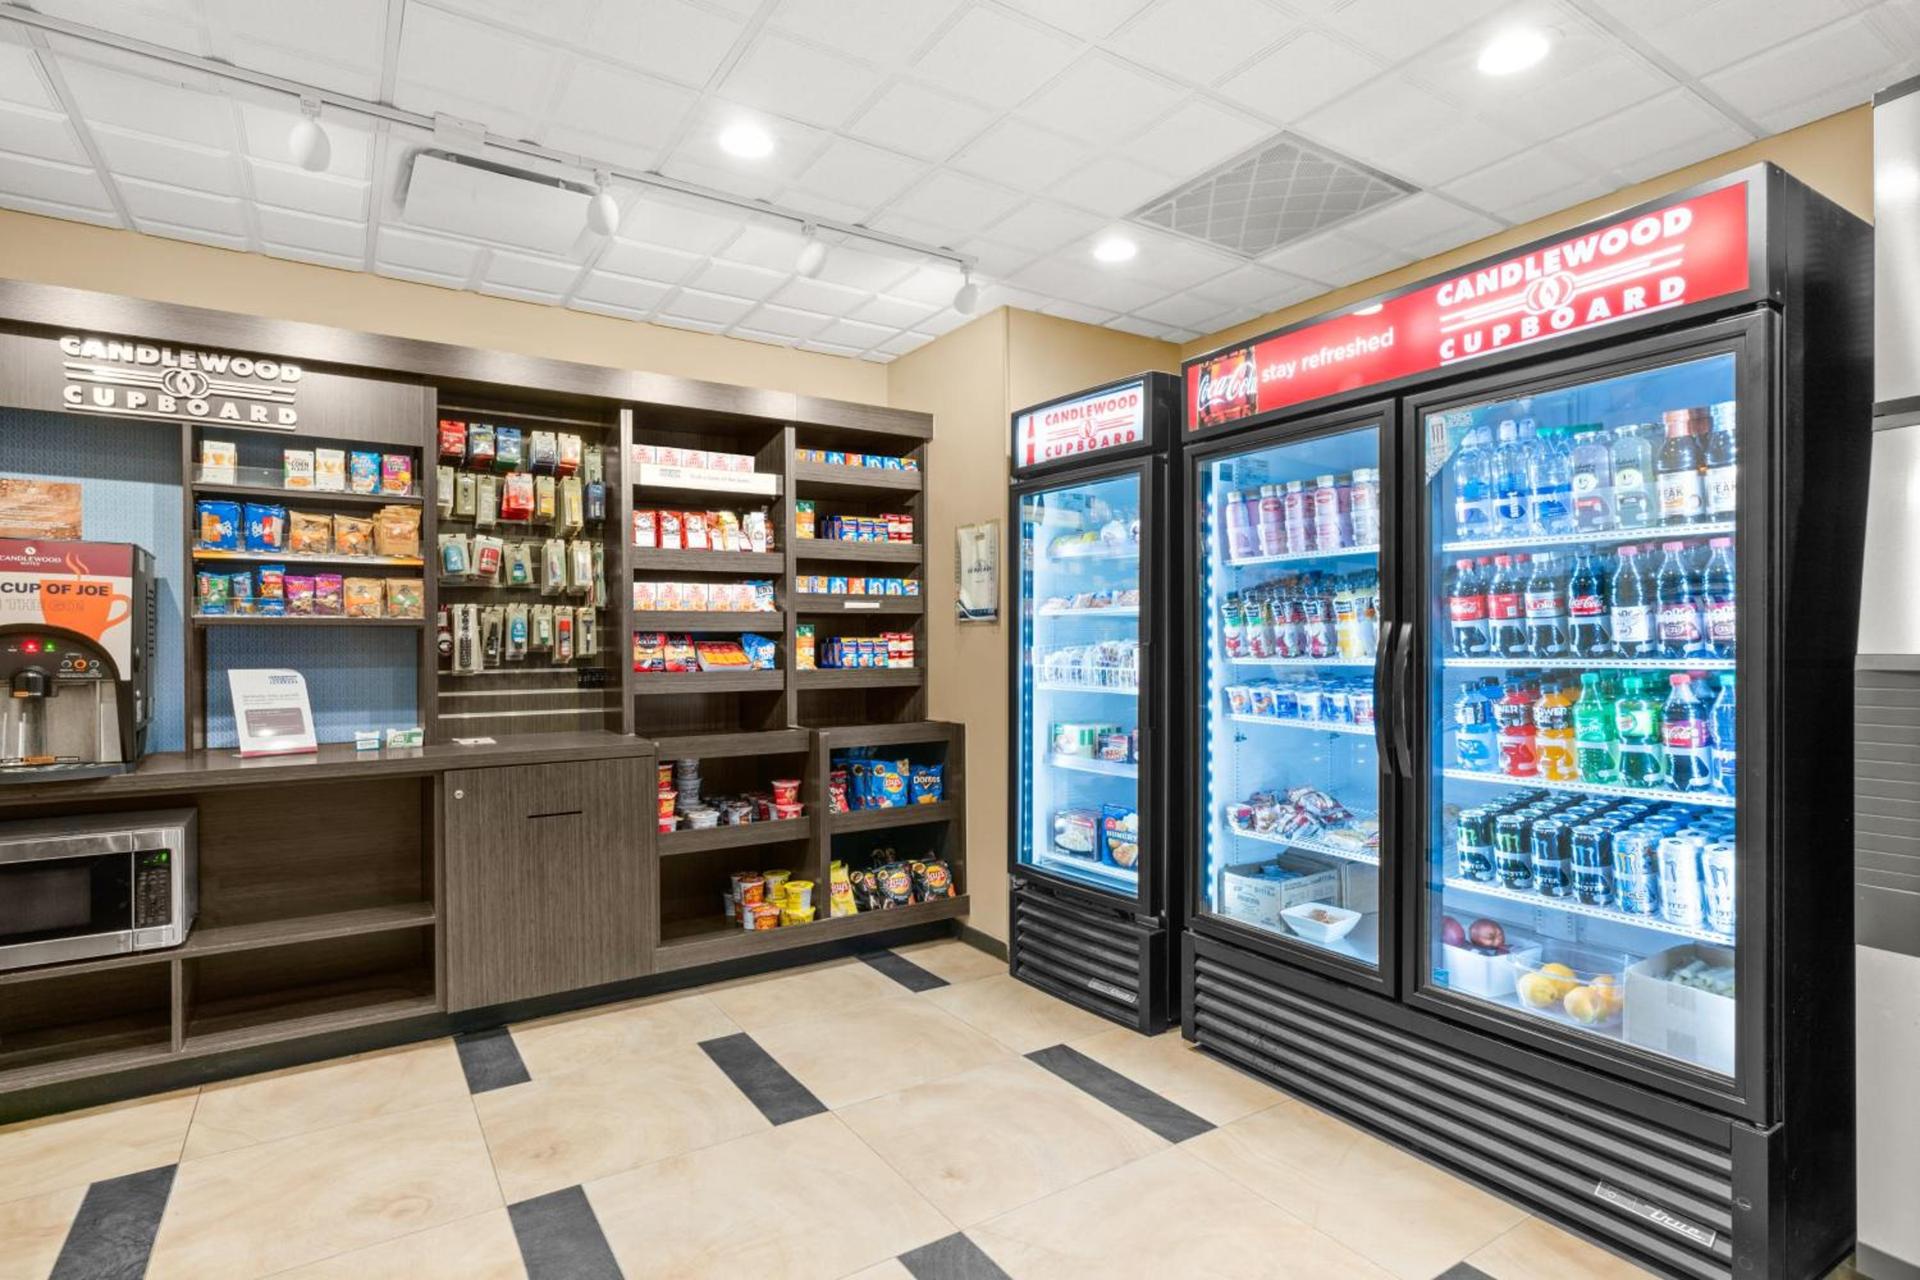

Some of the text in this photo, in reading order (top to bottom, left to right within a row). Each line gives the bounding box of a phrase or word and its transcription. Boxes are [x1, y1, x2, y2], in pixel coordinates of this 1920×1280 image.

[1436, 207, 1694, 308] CANDLEWOOD
[1440, 276, 1687, 361] CUPBOARD
[59, 335, 302, 383] CANDLEWOOD
[1261, 330, 1394, 383] stay refreshed
[63, 384, 298, 425] CUPBOARD
[1045, 394, 1138, 426] CANDLEWOOD
[1045, 430, 1135, 458] CUPBOARD
[1, 582, 110, 596] CUP OF JOE
